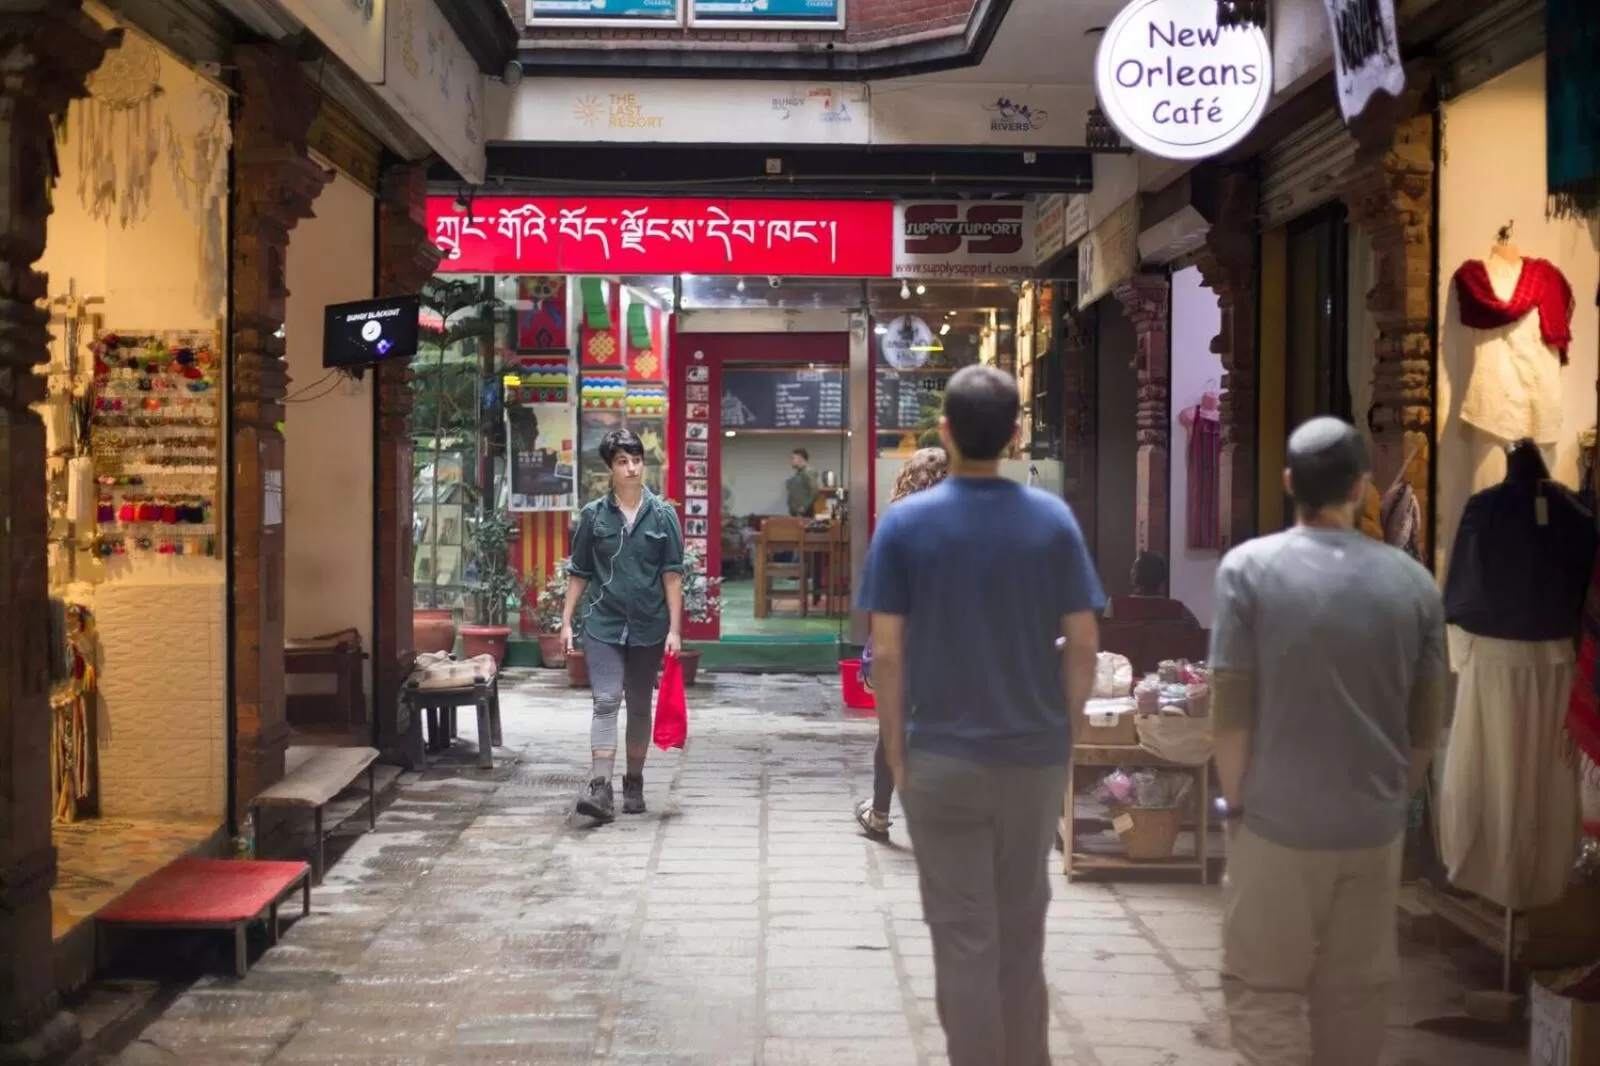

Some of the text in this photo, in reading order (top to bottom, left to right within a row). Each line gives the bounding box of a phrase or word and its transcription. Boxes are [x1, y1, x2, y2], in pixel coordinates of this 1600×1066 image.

[1148, 20, 1220, 49] New
[1116, 56, 1257, 88] Orleans
[609, 93, 637, 105] THE
[1152, 96, 1223, 125] Café
[608, 116, 665, 129] RESORT
[990, 121, 1030, 132] RIVERS
[905, 221, 1021, 236] SUPPLY SUPPORT
